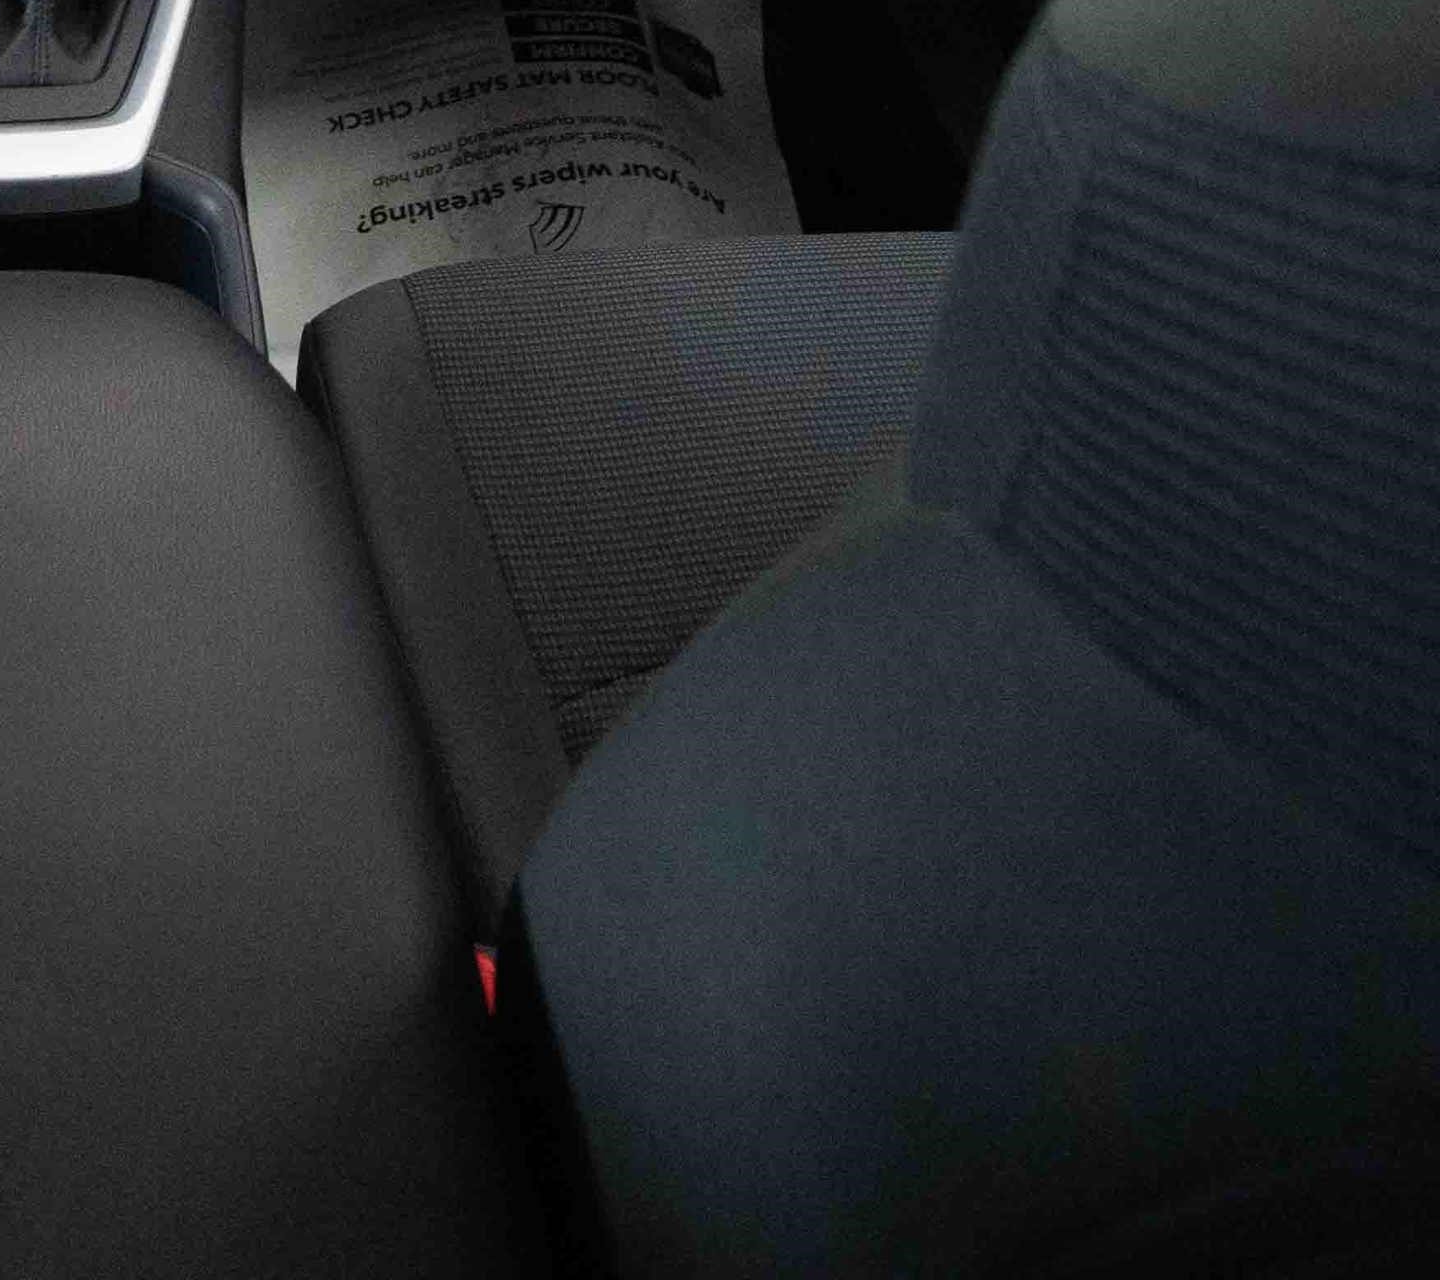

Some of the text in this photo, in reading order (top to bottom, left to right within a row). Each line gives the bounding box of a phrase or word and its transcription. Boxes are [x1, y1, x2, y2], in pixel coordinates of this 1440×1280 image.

[532, 17, 623, 36] SECURE
[529, 42, 639, 62] CONFIRM
[515, 71, 572, 89] MAT
[416, 74, 509, 111] SAFETY
[327, 100, 413, 134] CHECK
[456, 129, 489, 148] and
[524, 132, 588, 148] Service
[592, 132, 665, 151] Assistant
[406, 141, 453, 160] more.
[448, 138, 520, 168] Manager
[372, 170, 410, 190] help
[413, 162, 444, 181] can
[355, 160, 727, 234] Are your wipers streaking?
